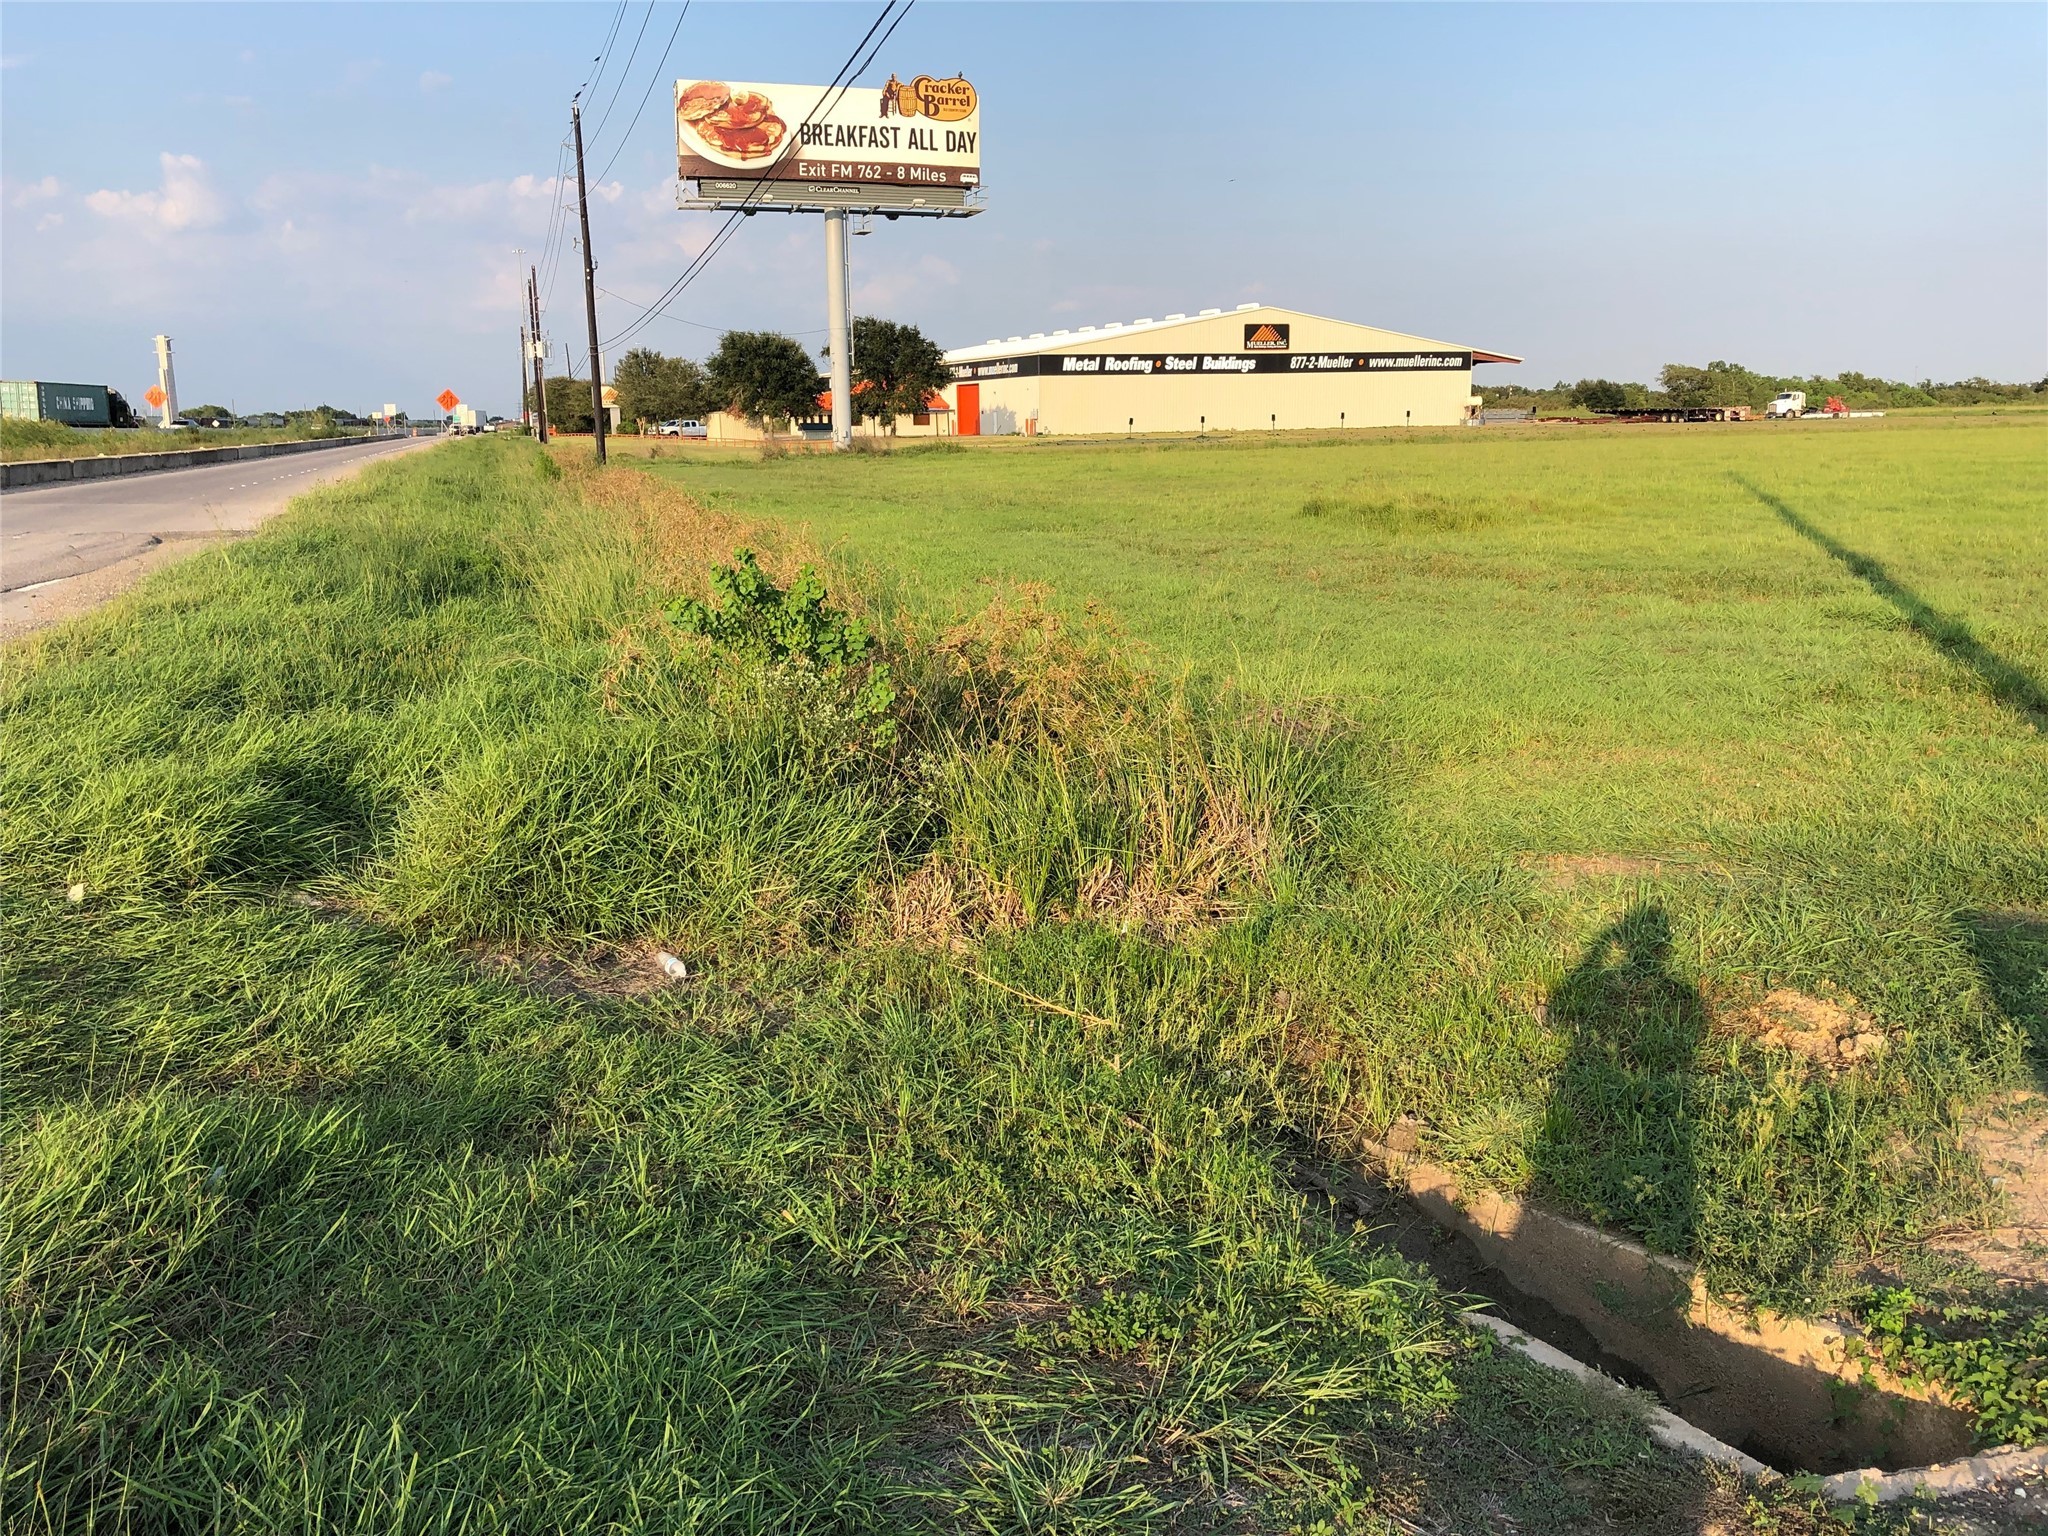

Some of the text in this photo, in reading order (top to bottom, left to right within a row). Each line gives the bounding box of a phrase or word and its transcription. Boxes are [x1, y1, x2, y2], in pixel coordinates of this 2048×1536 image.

[914, 77, 970, 102] Cracker
[924, 94, 970, 117] Barrel
[800, 122, 977, 154] BREAKFAST ALL DAY
[799, 162, 826, 177] Exit
[831, 163, 852, 178] FM
[857, 165, 882, 179] 762
[897, 166, 906, 180] 8
[910, 166, 947, 182] Miles
[1062, 355, 1257, 374] Metal Roofing Steel Buildings
[1289, 354, 1464, 370] 877-2-Mueller www.muellerinc.com
